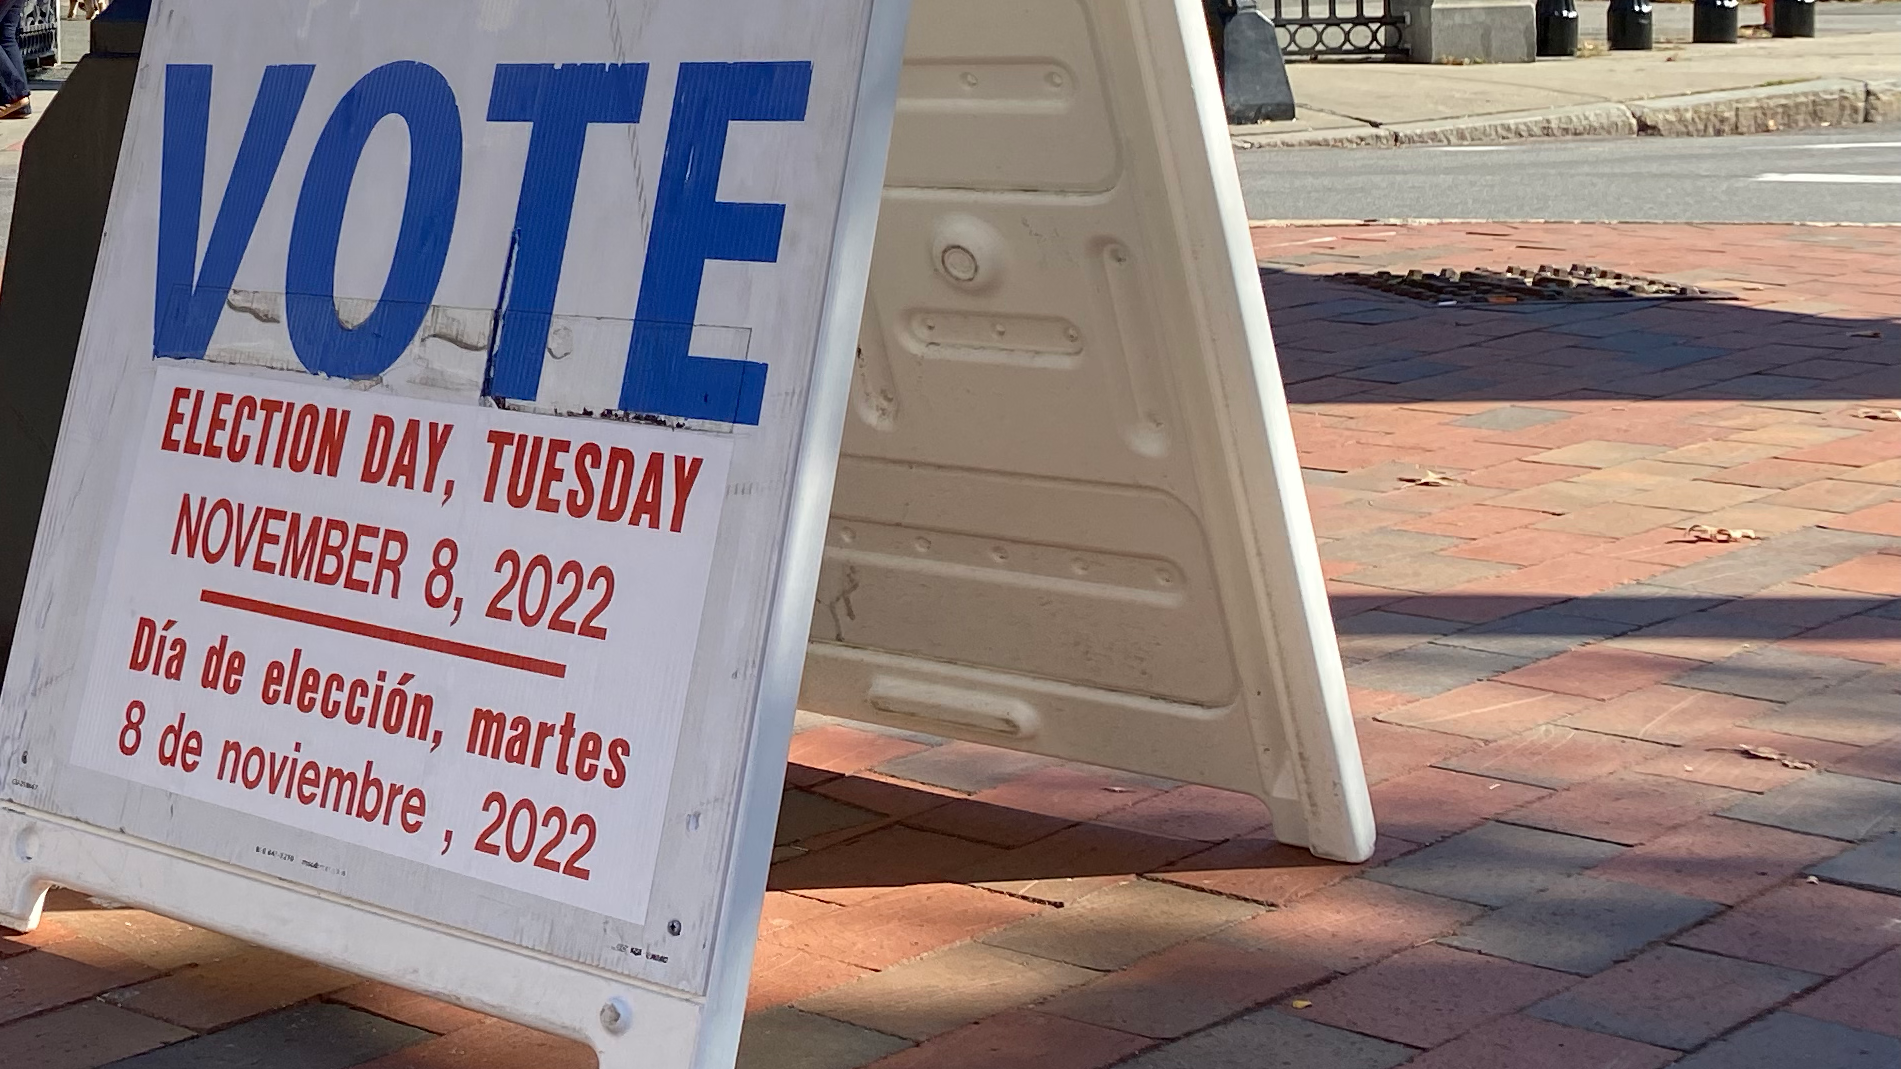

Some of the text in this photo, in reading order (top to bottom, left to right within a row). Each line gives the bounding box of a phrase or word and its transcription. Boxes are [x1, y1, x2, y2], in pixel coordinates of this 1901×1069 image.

[153, 60, 812, 426] VOTE
[161, 387, 704, 533] ELECTION DAY, TUESDAY
[171, 494, 615, 641] NOVEMBER 8, 2022
[128, 616, 631, 789] Día de elección, martes
[118, 700, 146, 756] 8
[158, 712, 202, 772] de
[217, 739, 427, 834] noviembre
[475, 792, 598, 881] 2022
